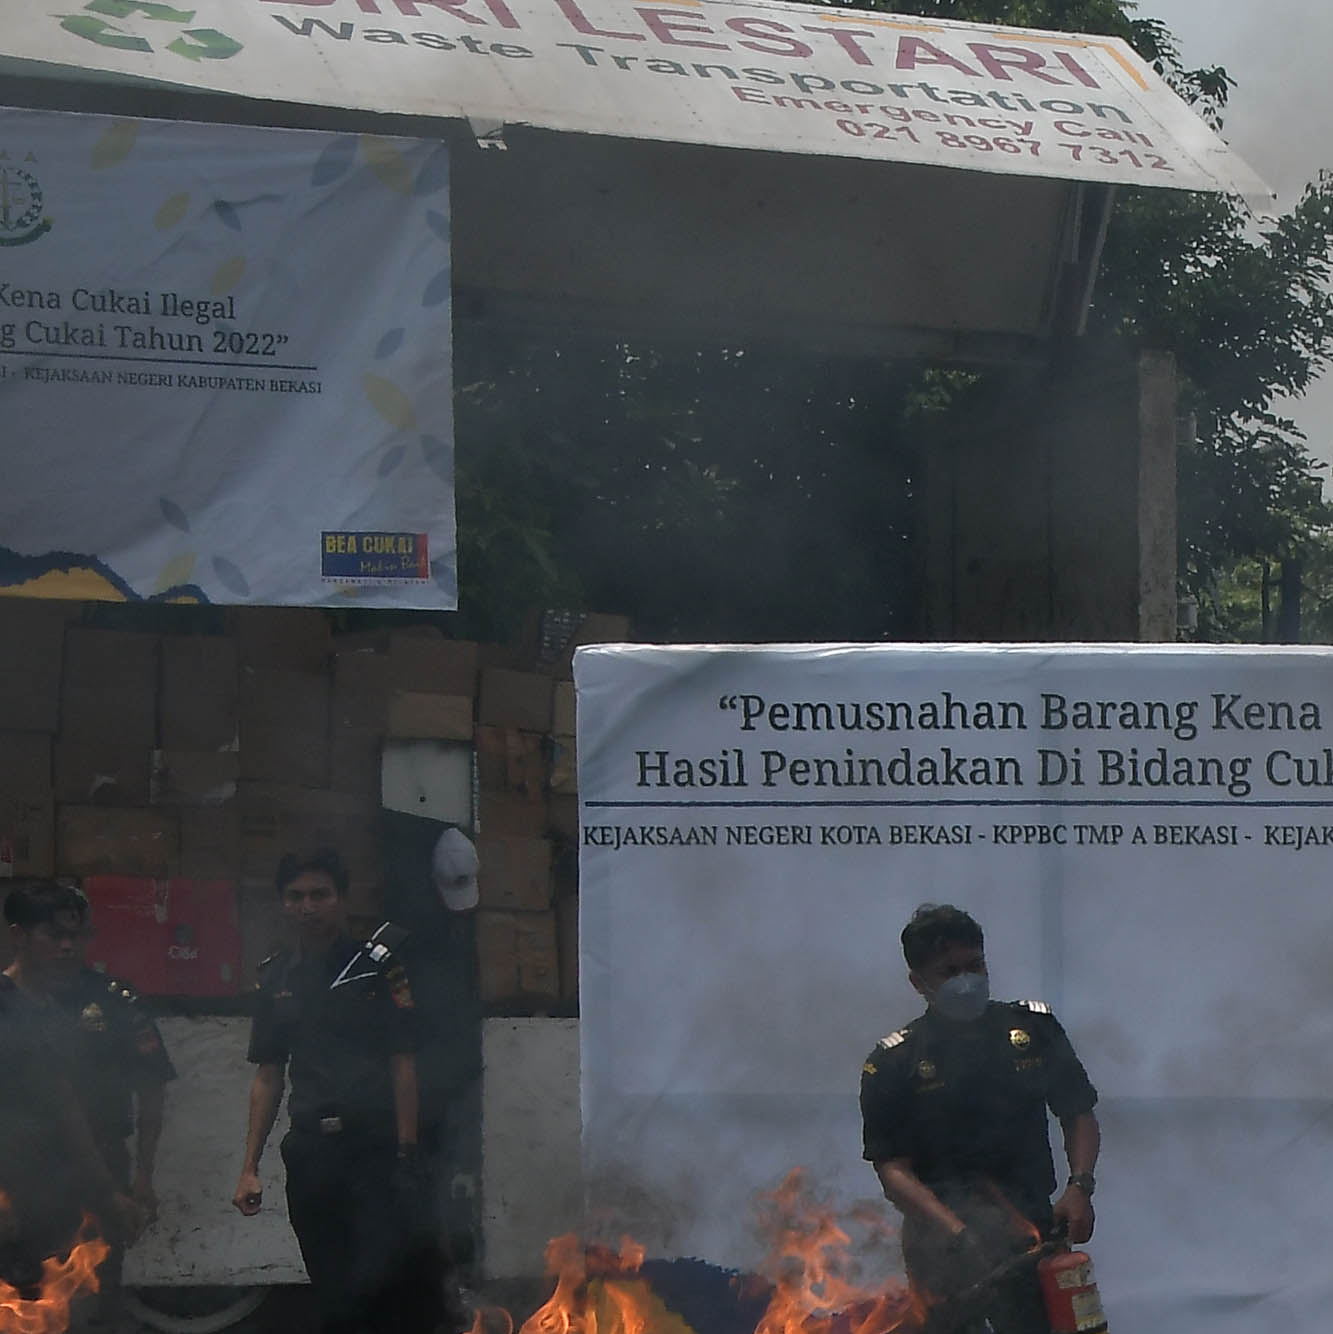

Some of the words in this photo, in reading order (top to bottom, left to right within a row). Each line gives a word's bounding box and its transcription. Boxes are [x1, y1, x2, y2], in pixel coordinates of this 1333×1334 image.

[557, 0, 1101, 89] LESTARI
[271, 14, 535, 58] Waste
[555, 42, 1134, 125] Transportation
[730, 86, 1035, 138] Emergency
[1053, 116, 1155, 148] Call
[836, 118, 921, 146] 021
[935, 131, 1041, 157] 8967
[1054, 143, 1176, 173] 7312
[71, 288, 152, 316] Cukai
[160, 292, 237, 325] Ilegal
[25, 320, 106, 347] Cukai
[113, 325, 203, 353] Tahun
[24, 368, 113, 385] KEJAKSAAN
[117, 372, 173, 388] NEGERI
[177, 375, 266, 392] KABUPATEN
[269, 379, 322, 394] BEKASI
[325, 535, 357, 553] BEA
[362, 535, 413, 553] CUKAI
[1040, 693, 1199, 741] Barang
[1211, 693, 1322, 731] Kena
[634, 748, 747, 788] Hasil
[760, 748, 1023, 788] Penindakan
[1036, 748, 1082, 787] Di
[1098, 748, 1253, 797] Bidang
[583, 824, 718, 850] KEJAKSAAN
[724, 824, 813, 846] NEGERI
[820, 824, 882, 846] KOTA
[889, 824, 972, 846] BEKASI
[991, 824, 1068, 846] KPPBC
[1073, 824, 1124, 846] TMP
[1130, 824, 1148, 846] A
[1152, 824, 1239, 846] BEKASI
